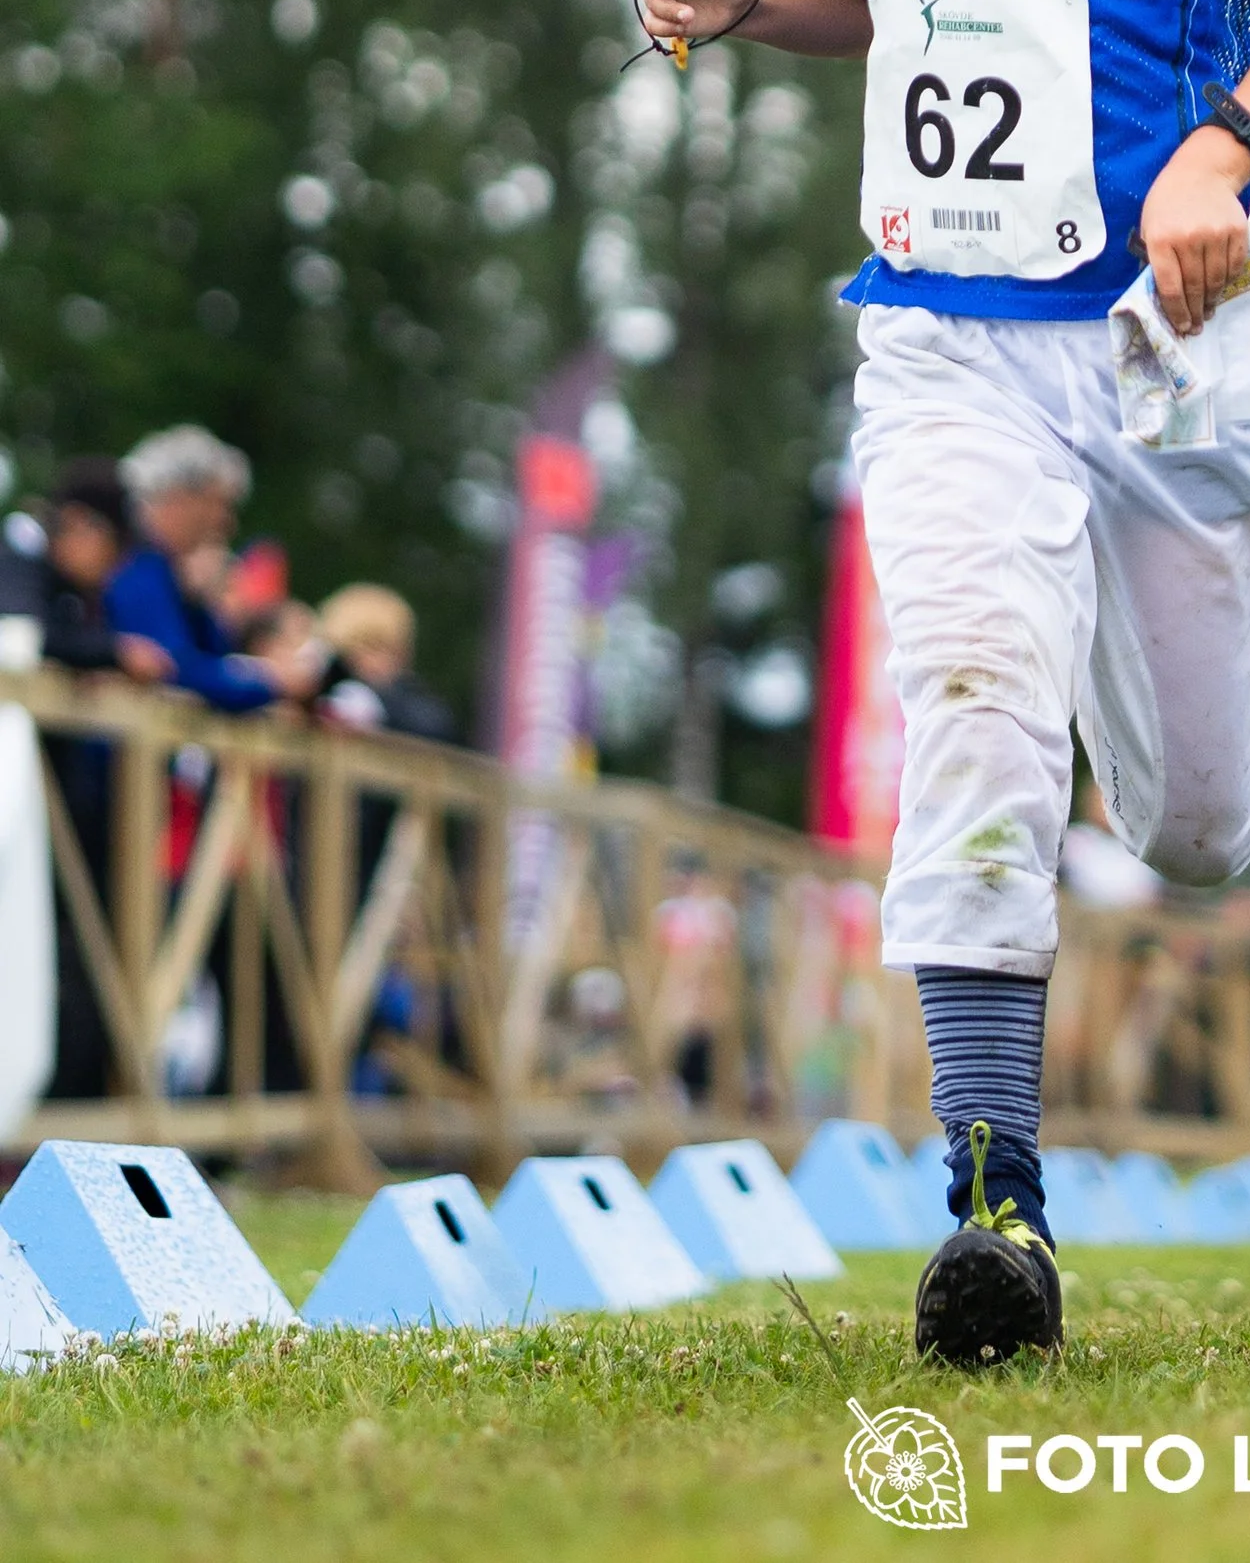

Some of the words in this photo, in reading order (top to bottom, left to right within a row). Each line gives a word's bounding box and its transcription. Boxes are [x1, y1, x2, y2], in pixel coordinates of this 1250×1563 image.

[939, 21, 1003, 32] REHABCENTER
[905, 73, 1024, 181] 62
[1056, 220, 1082, 254] 8
